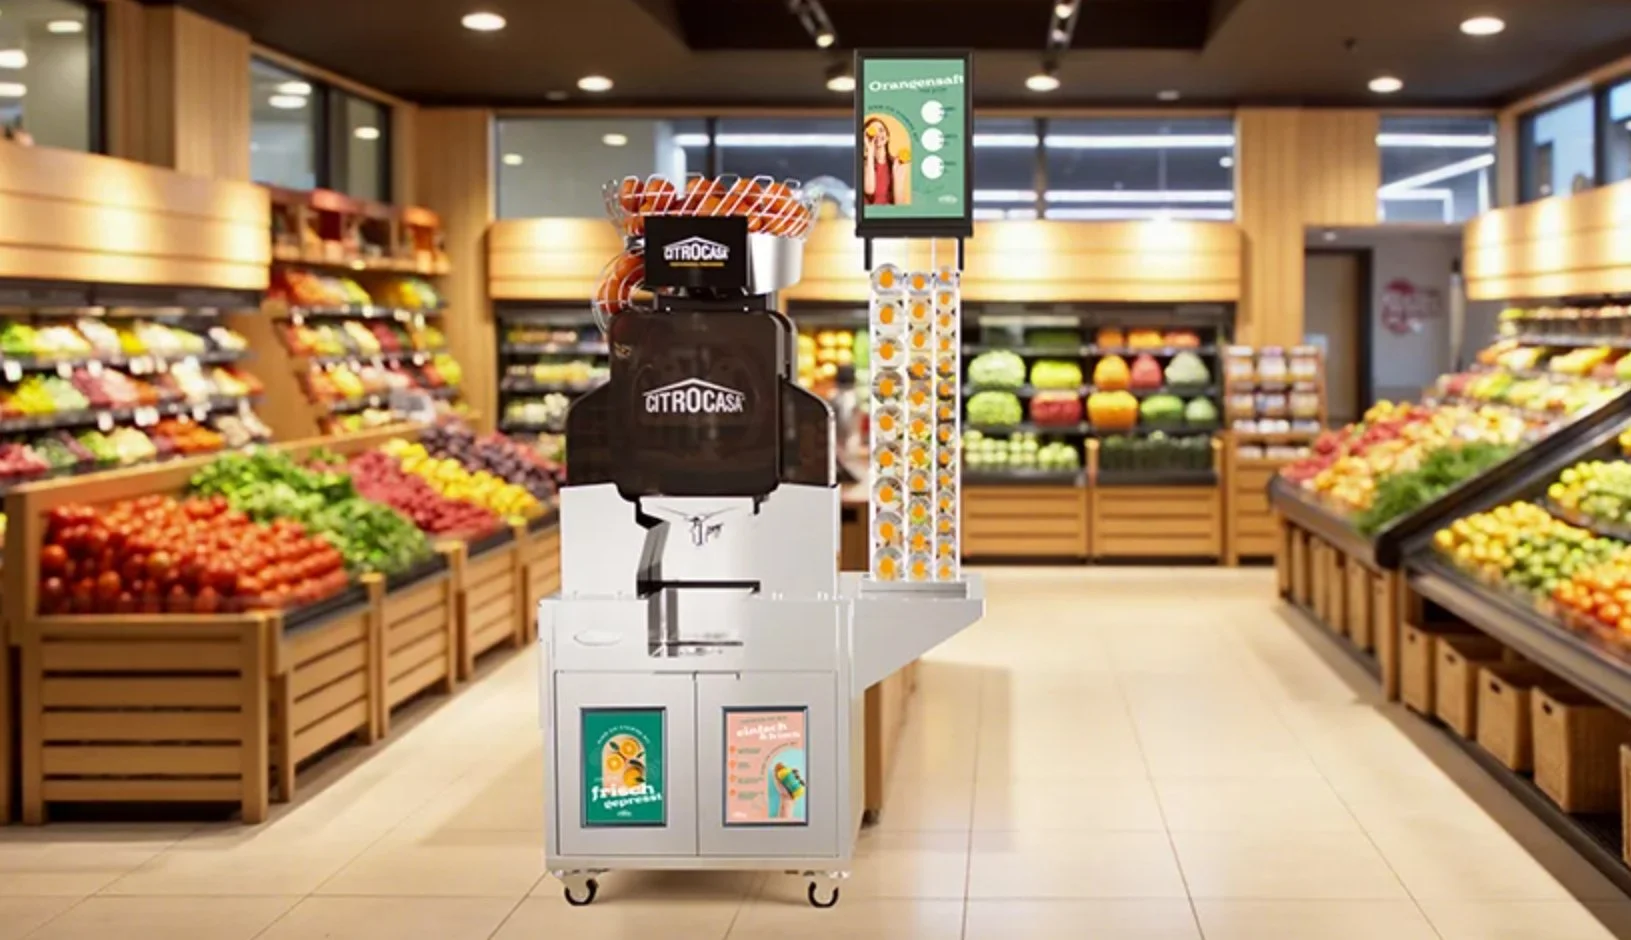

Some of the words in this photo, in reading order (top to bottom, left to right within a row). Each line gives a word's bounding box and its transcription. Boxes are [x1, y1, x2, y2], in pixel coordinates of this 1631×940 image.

[664, 243, 729, 260] CITROCASA
[645, 387, 743, 413] CITROCASA
[591, 783, 655, 802] frisch
